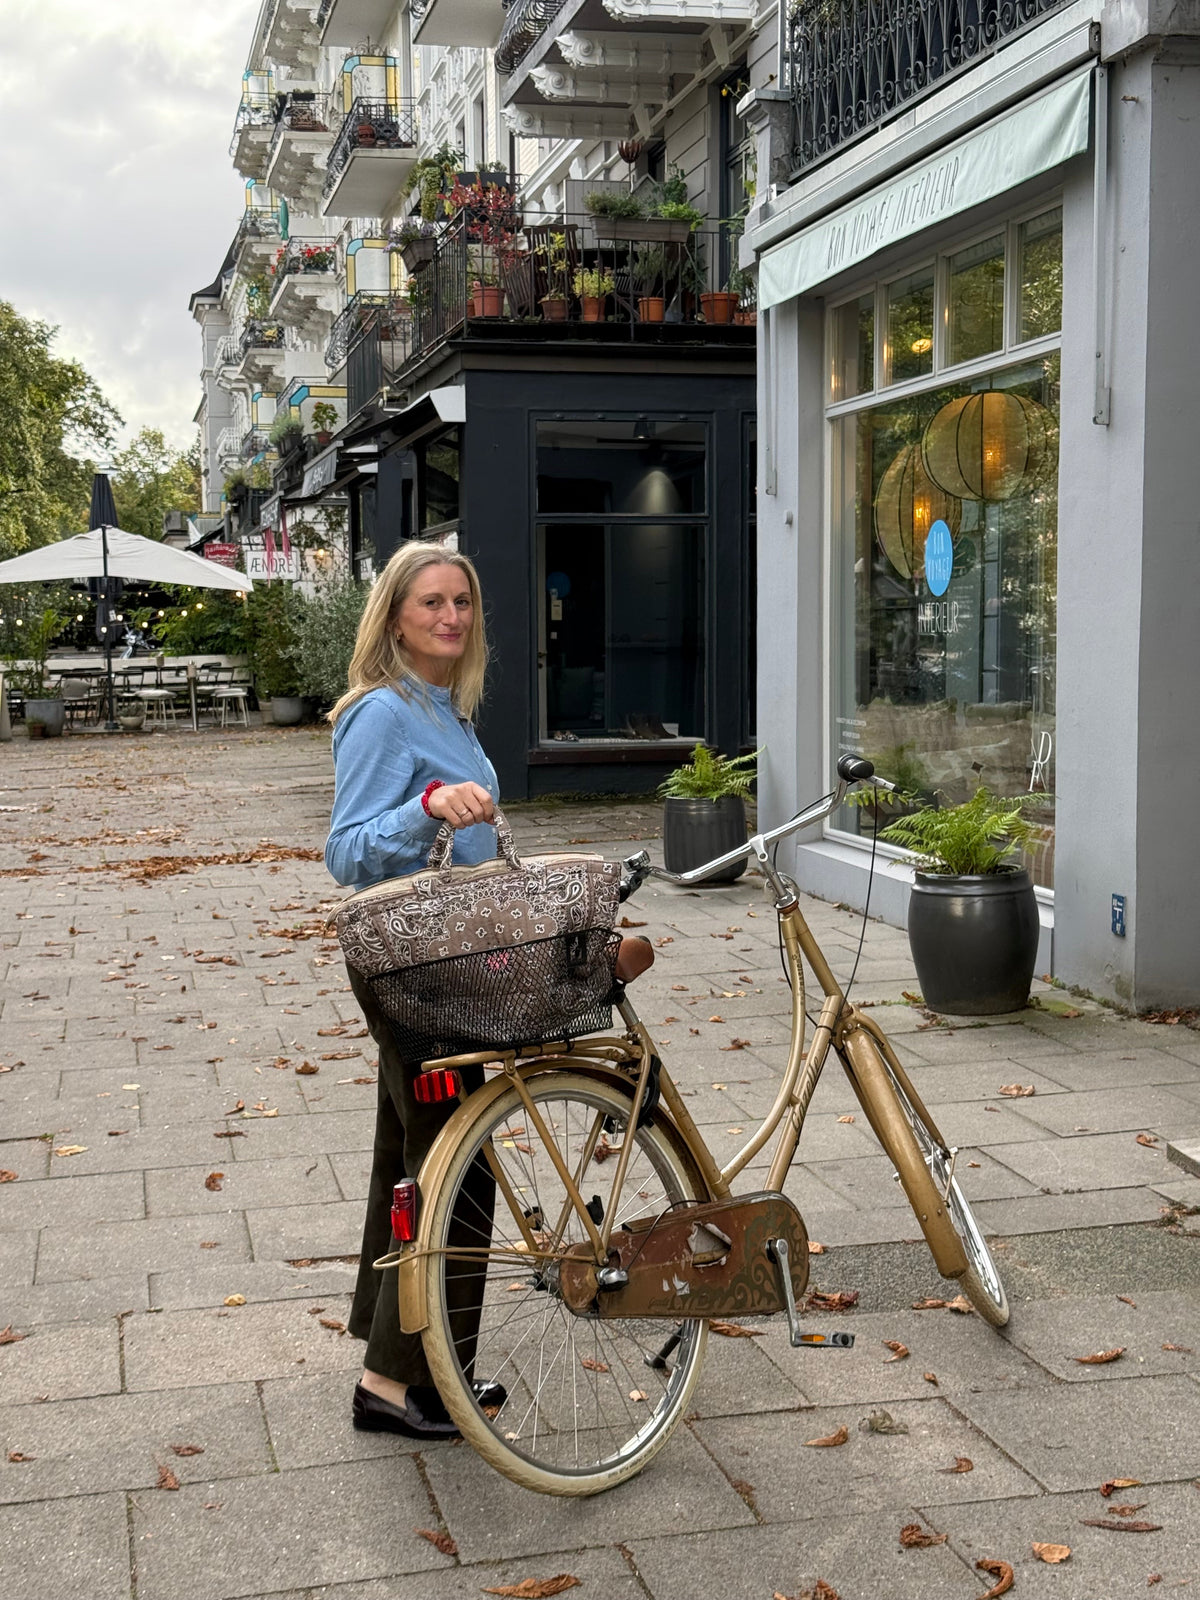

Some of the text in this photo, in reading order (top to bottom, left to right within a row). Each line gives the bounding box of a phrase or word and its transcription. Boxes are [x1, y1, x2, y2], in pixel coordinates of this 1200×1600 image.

[827, 156, 960, 270] BON VOYAGE INTERIEUR
[917, 601, 960, 633] INTERIEUR
